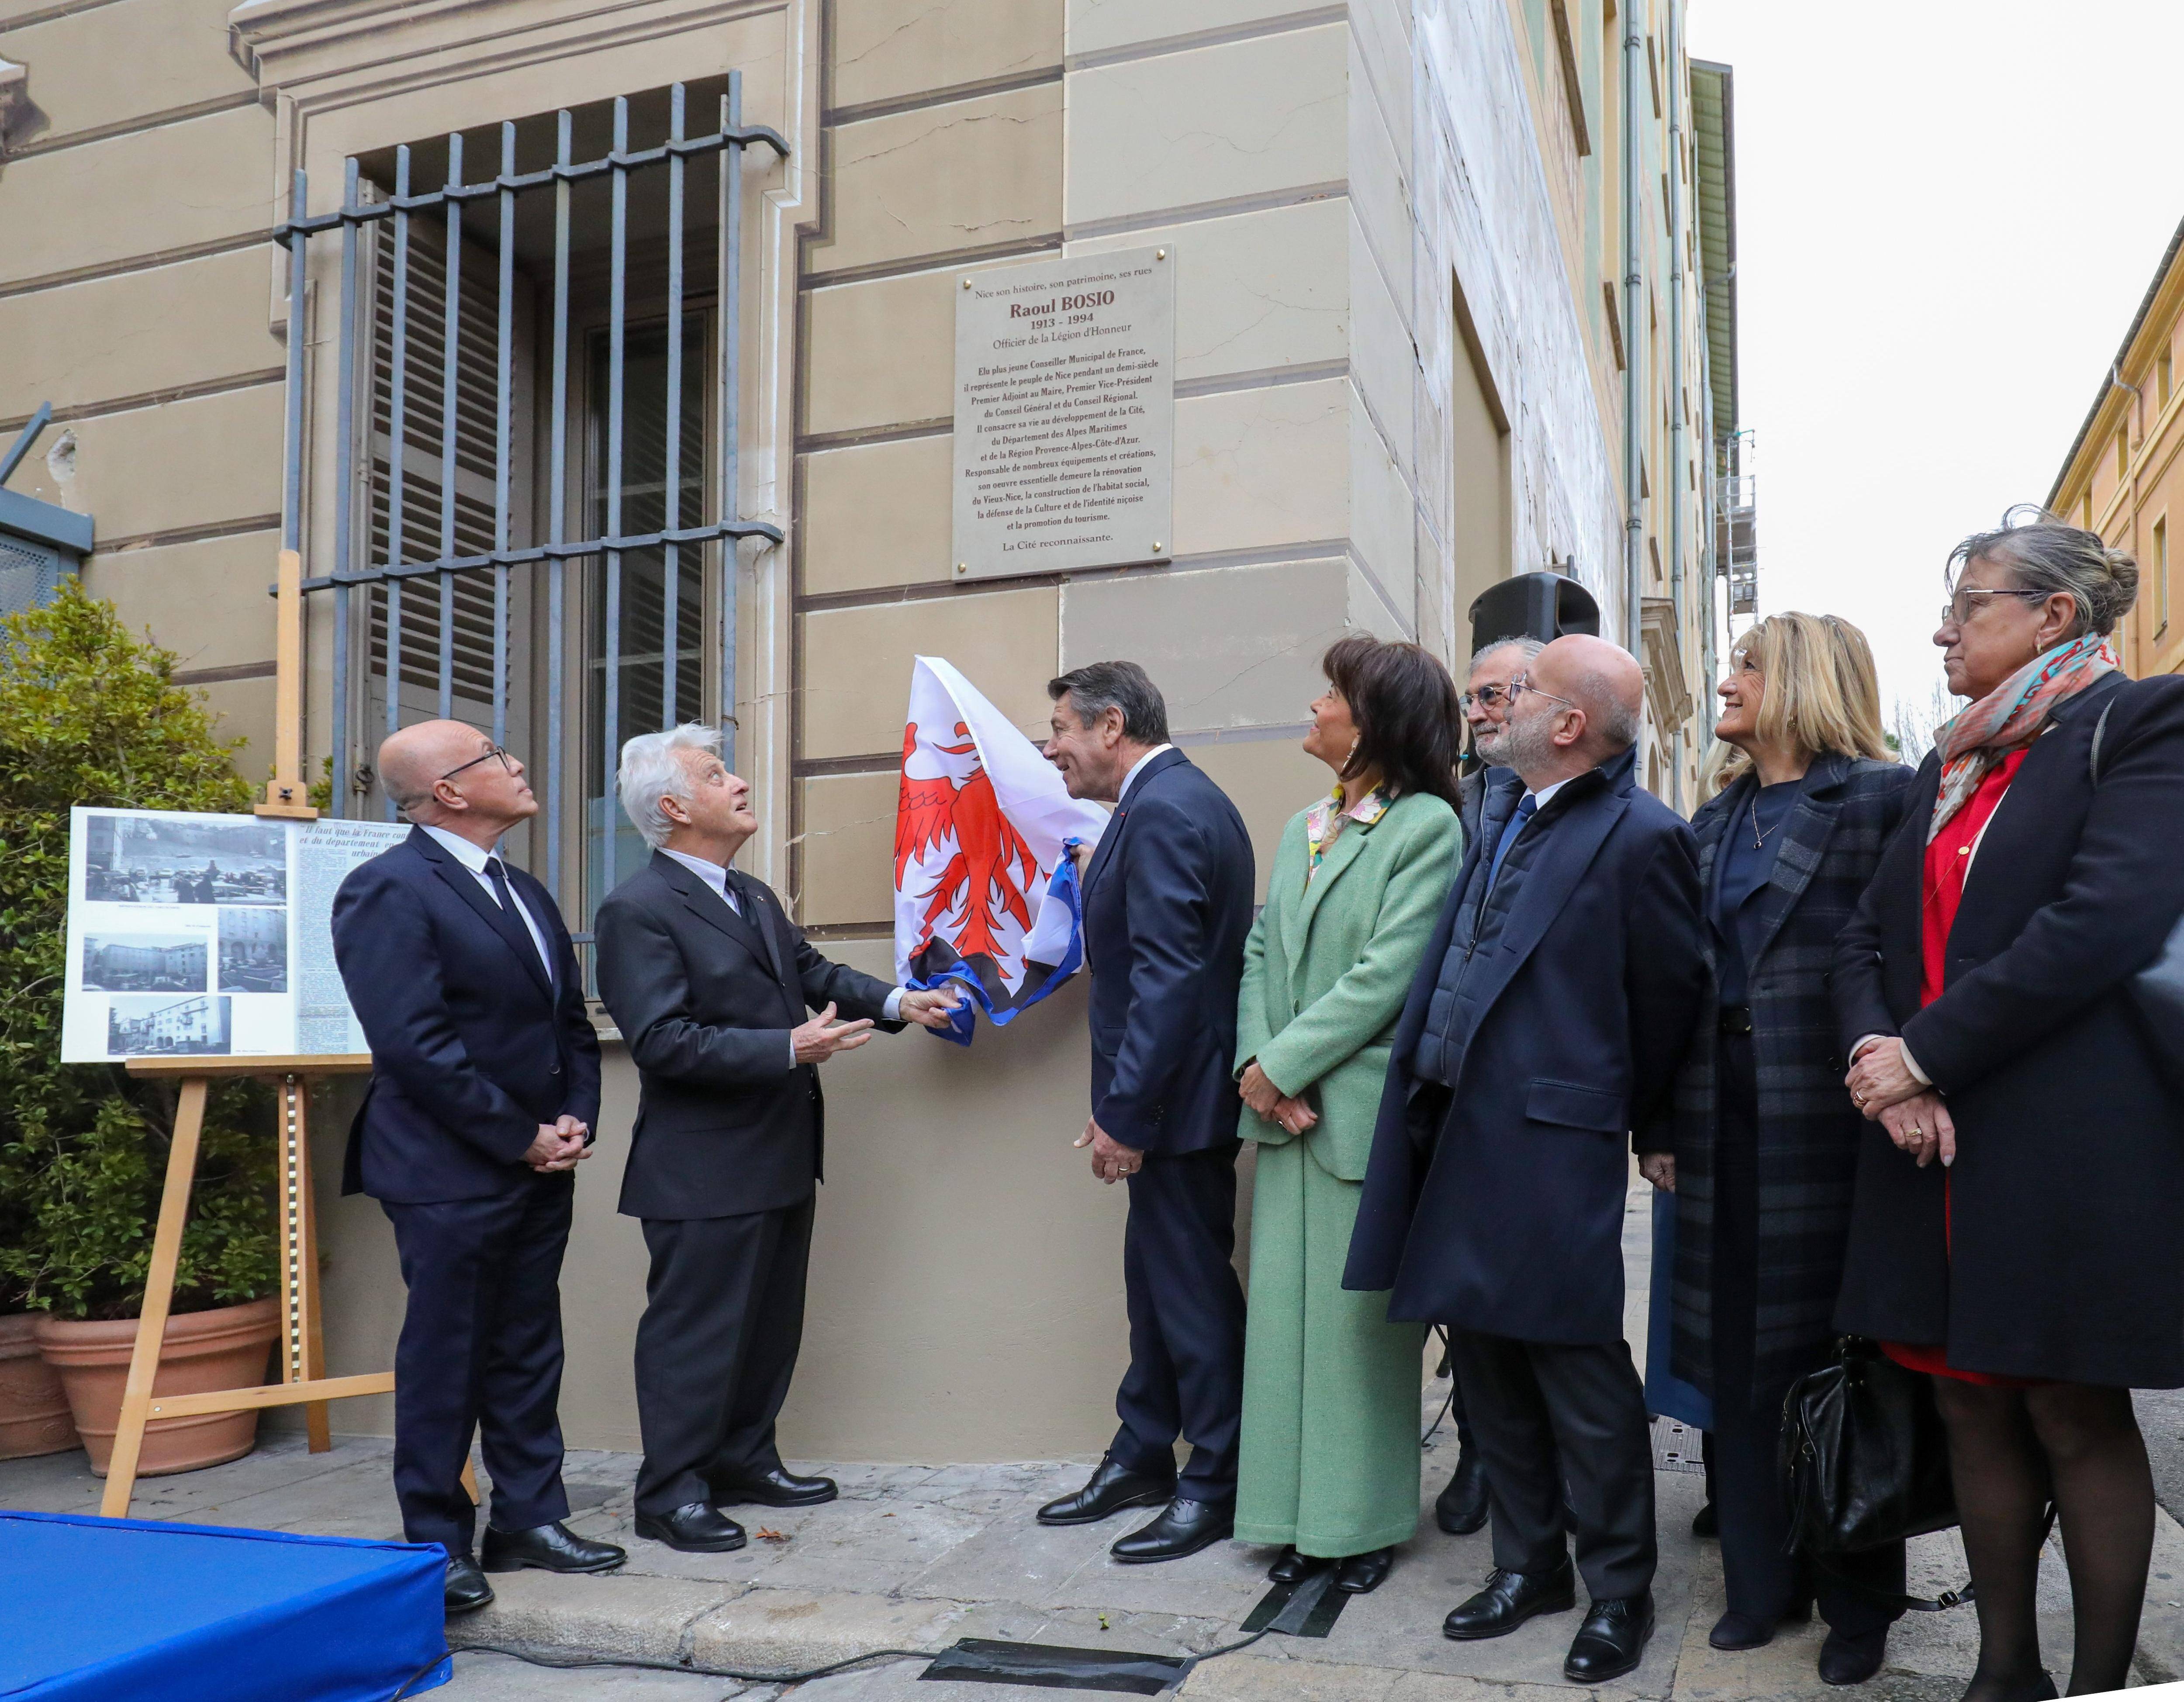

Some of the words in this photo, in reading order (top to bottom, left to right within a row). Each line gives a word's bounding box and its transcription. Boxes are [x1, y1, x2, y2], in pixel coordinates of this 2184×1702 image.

[1013, 283, 1047, 293] histoire,
[1067, 273, 1116, 287] patrimoine,
[1010, 299, 1056, 318] Raoul
[1061, 290, 1114, 311] BOSIO
[1031, 319, 1055, 329] 1913
[1068, 313, 1094, 325] 1994
[993, 339, 1026, 349] Officier
[1029, 335, 1038, 344] de
[1041, 334, 1048, 342] la
[1052, 331, 1081, 342] Légion
[1084, 325, 1131, 337] d'Honneur
[978, 367, 990, 376] Elu
[992, 366, 1006, 375] plus
[1008, 364, 1028, 373] jeune
[1030, 357, 1067, 369] Conseiller
[1069, 351, 1105, 364] Municipal
[1107, 350, 1116, 359] de
[1118, 349, 1146, 357] France,
[971, 380, 1008, 392] représente
[1019, 375, 1042, 386] peuple
[1055, 371, 1071, 380] Nice
[1074, 368, 1102, 379] pendant
[1117, 359, 1158, 372] demi-siècle
[971, 396, 1000, 405] Premier
[1002, 392, 1028, 401] Adjoint
[1041, 387, 1064, 396] Maire,
[1067, 383, 1096, 393] Premier
[1098, 376, 1152, 389] Vice-Président
[996, 406, 1021, 416] Conseil
[1024, 402, 1051, 413] Général
[1075, 396, 1101, 406] Conseil
[1103, 392, 1138, 403] Régional.
[984, 423, 1016, 432] consacre
[1052, 411, 1106, 424] développement
[1129, 405, 1144, 414] Cité,
[1003, 432, 1049, 445] Département
[1066, 428, 1087, 437] Alpes
[1089, 424, 1127, 434] Maritimes
[1009, 449, 1033, 458] Région
[1035, 437, 1140, 455] Provence-Alpes-Côte-d'Azur.
[965, 465, 1010, 477] Responsable
[1023, 461, 1058, 470] nombreux
[1061, 455, 1108, 467] équipements
[1119, 450, 1156, 459] créations,
[1019, 474, 1057, 485] essentielle
[1060, 471, 1091, 480] demeure
[1102, 466, 1141, 476] rénovation
[984, 493, 1023, 503] Vieux-Nice,
[1034, 487, 1080, 498] construction
[1093, 480, 1123, 491] l'habitat
[1125, 478, 1149, 488] social,
[986, 509, 1013, 518] défense
[1035, 504, 1061, 512] Culture
[1084, 497, 1114, 507] l'identité
[1117, 494, 1143, 504] niçoise
[1024, 518, 1061, 529] promotion
[1064, 516, 1072, 524] du
[1075, 514, 1109, 523] tourisme.
[1018, 540, 1037, 549] Cité
[1040, 535, 1113, 547] reconnaissante.
[364, 829, 390, 838] France
